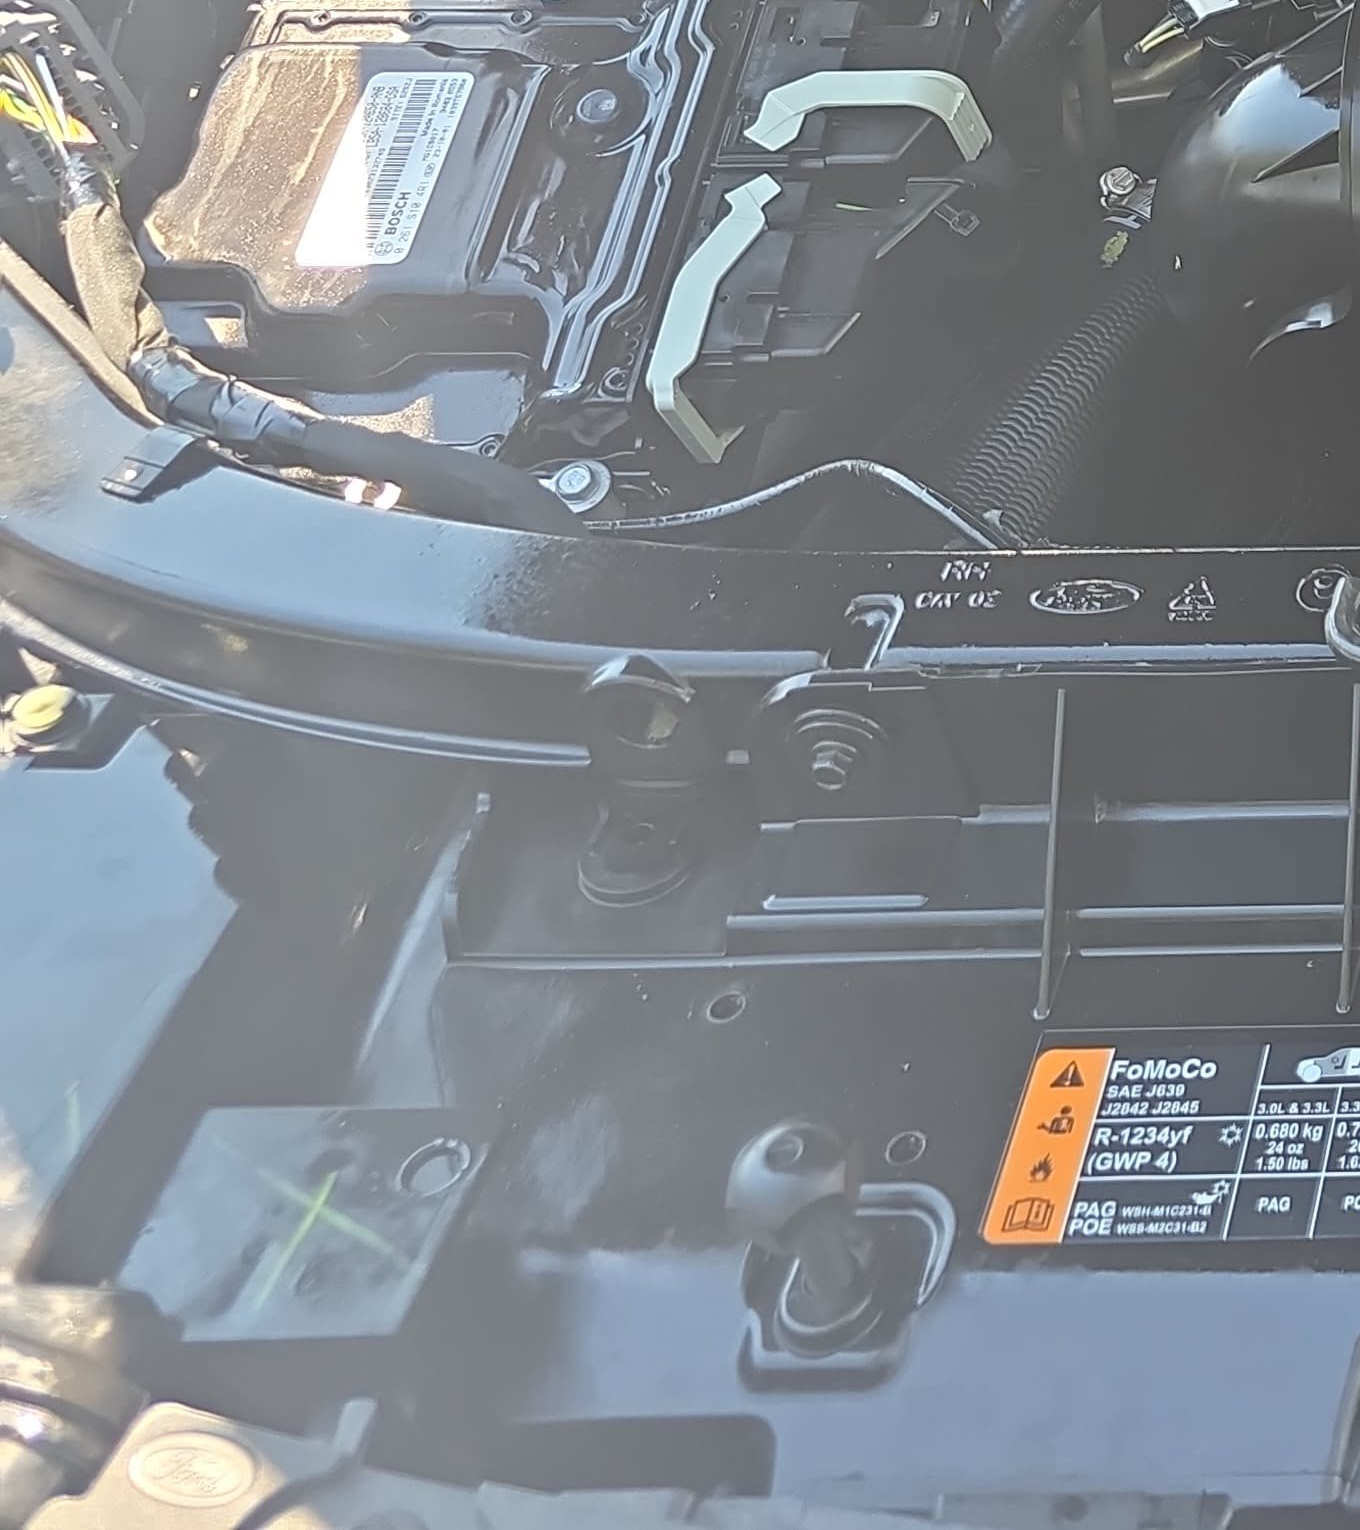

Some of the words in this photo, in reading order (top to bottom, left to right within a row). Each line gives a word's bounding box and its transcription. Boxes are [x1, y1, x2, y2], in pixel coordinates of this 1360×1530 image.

[383, 192, 411, 234] BOSCH
[1108, 1058, 1218, 1081] FoMoCo
[1106, 1084, 1142, 1098] SAE
[1146, 1083, 1186, 1098] J639
[1100, 1101, 1149, 1117] J2842
[1152, 1100, 1200, 1116] J2845
[1257, 1103, 1286, 1115] 3.0L
[1289, 1102, 1299, 1114] &
[1303, 1101, 1331, 1114] 3.3L
[1094, 1125, 1194, 1147] R-1234yf
[1254, 1122, 1300, 1140] 0.680
[1303, 1122, 1324, 1143] kg
[1266, 1141, 1285, 1155] 24
[1287, 1143, 1305, 1155] oz
[1087, 1151, 1153, 1174] (GWP
[1155, 1150, 1178, 1172] 4)
[1255, 1157, 1285, 1171] 1.50
[1288, 1156, 1309, 1170] lbs
[1073, 1201, 1117, 1218] PAG
[1257, 1196, 1292, 1213] PAG
[1069, 1218, 1113, 1236] POE
